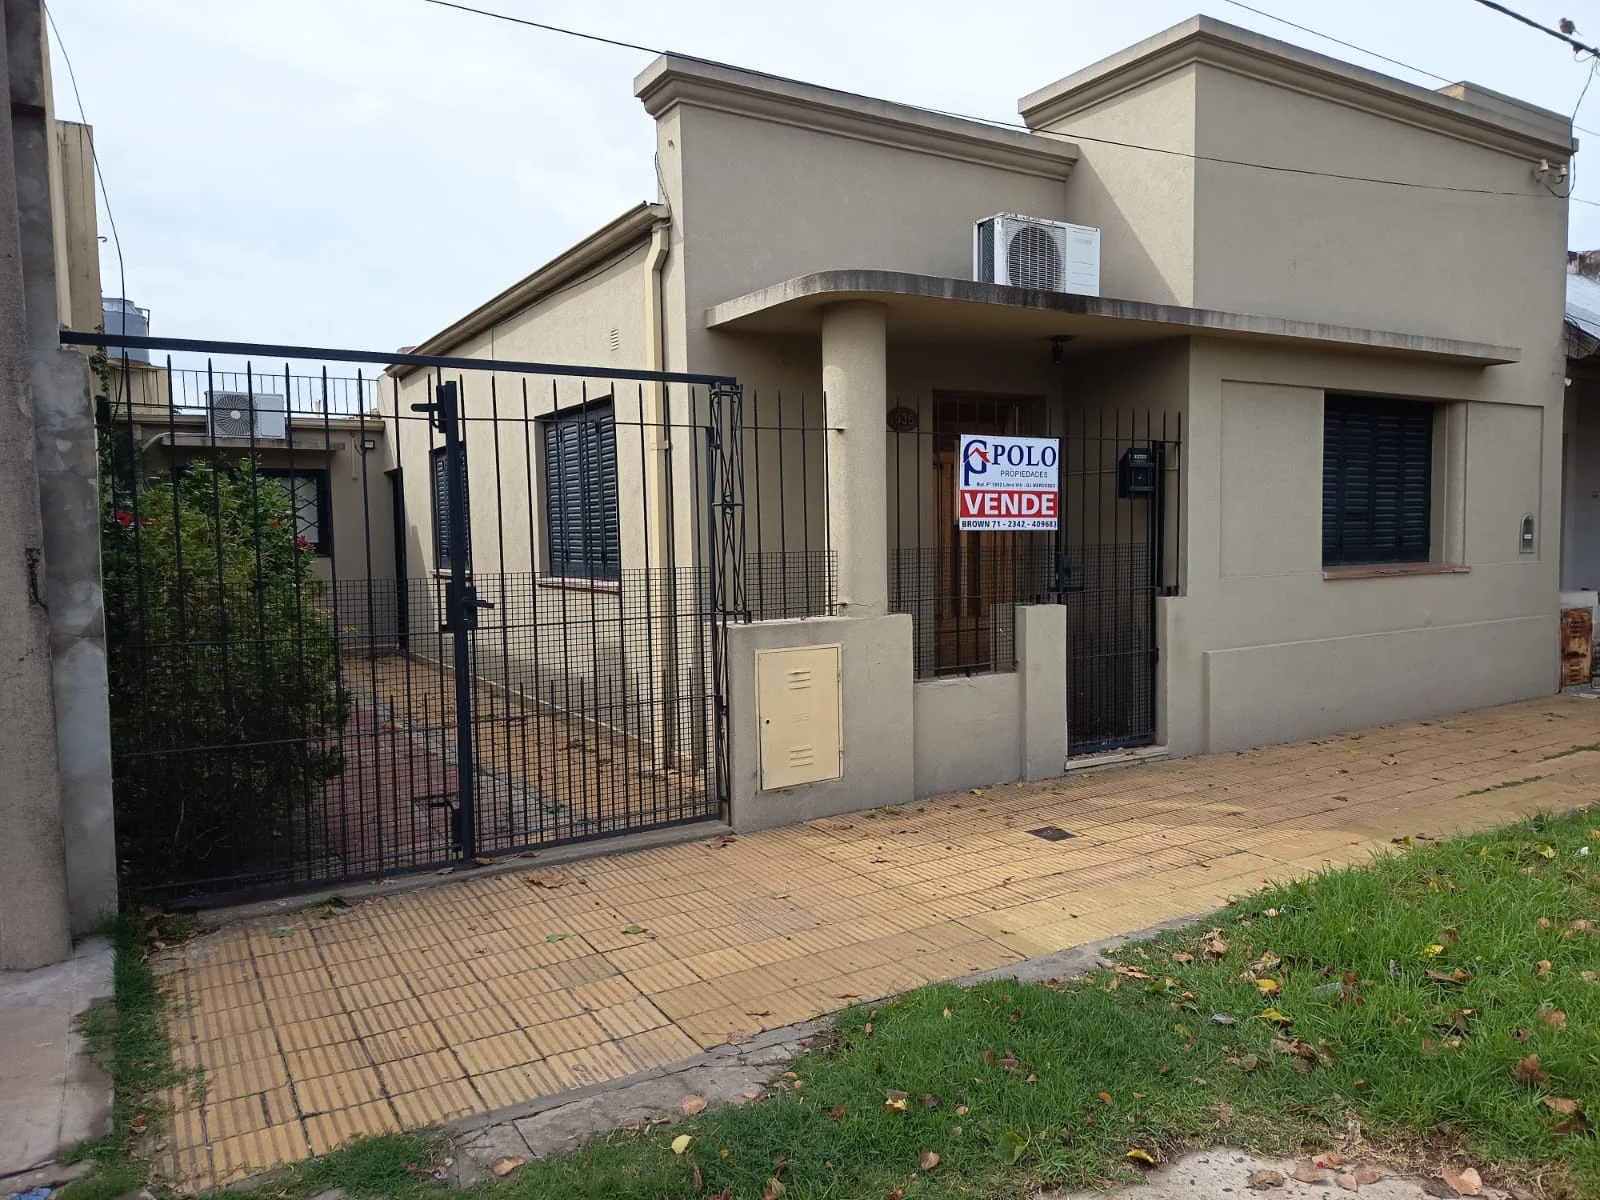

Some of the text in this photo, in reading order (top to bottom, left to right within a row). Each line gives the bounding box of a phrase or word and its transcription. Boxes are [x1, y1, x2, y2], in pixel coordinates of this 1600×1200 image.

[1000, 470, 1048, 478] PROPIEDADES
[964, 492, 1054, 515] VENDE
[961, 520, 990, 528] BROWN
[1007, 520, 1025, 528] 2342
